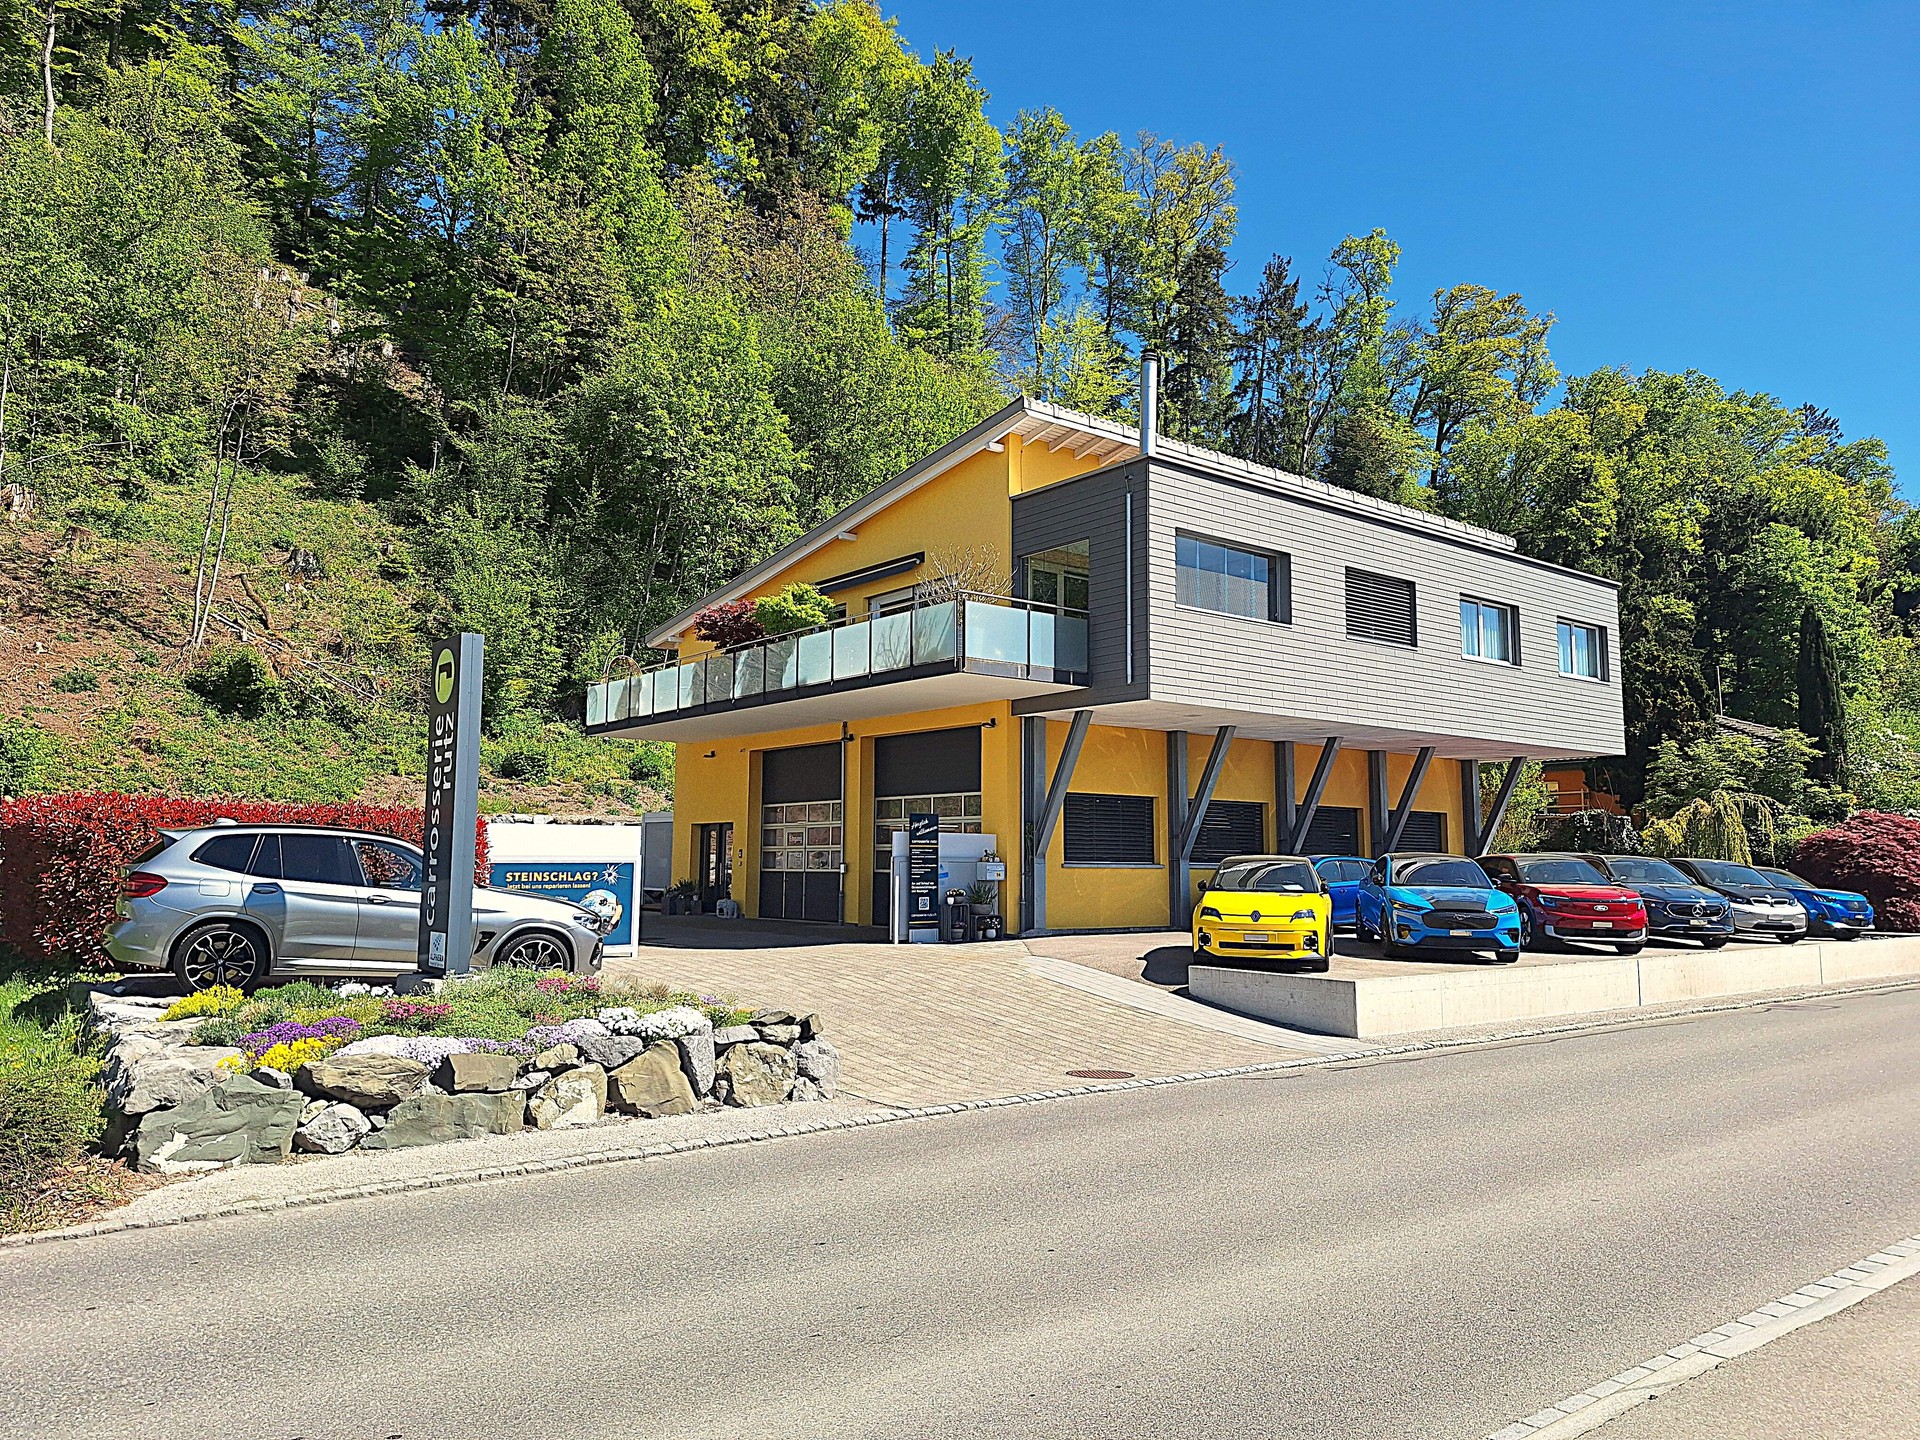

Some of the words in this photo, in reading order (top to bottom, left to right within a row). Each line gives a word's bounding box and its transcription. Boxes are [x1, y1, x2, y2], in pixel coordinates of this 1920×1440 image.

[442, 711, 455, 790] rutz
[426, 714, 444, 926] carrosserie
[505, 871, 599, 882] STEINSCHLAG?
